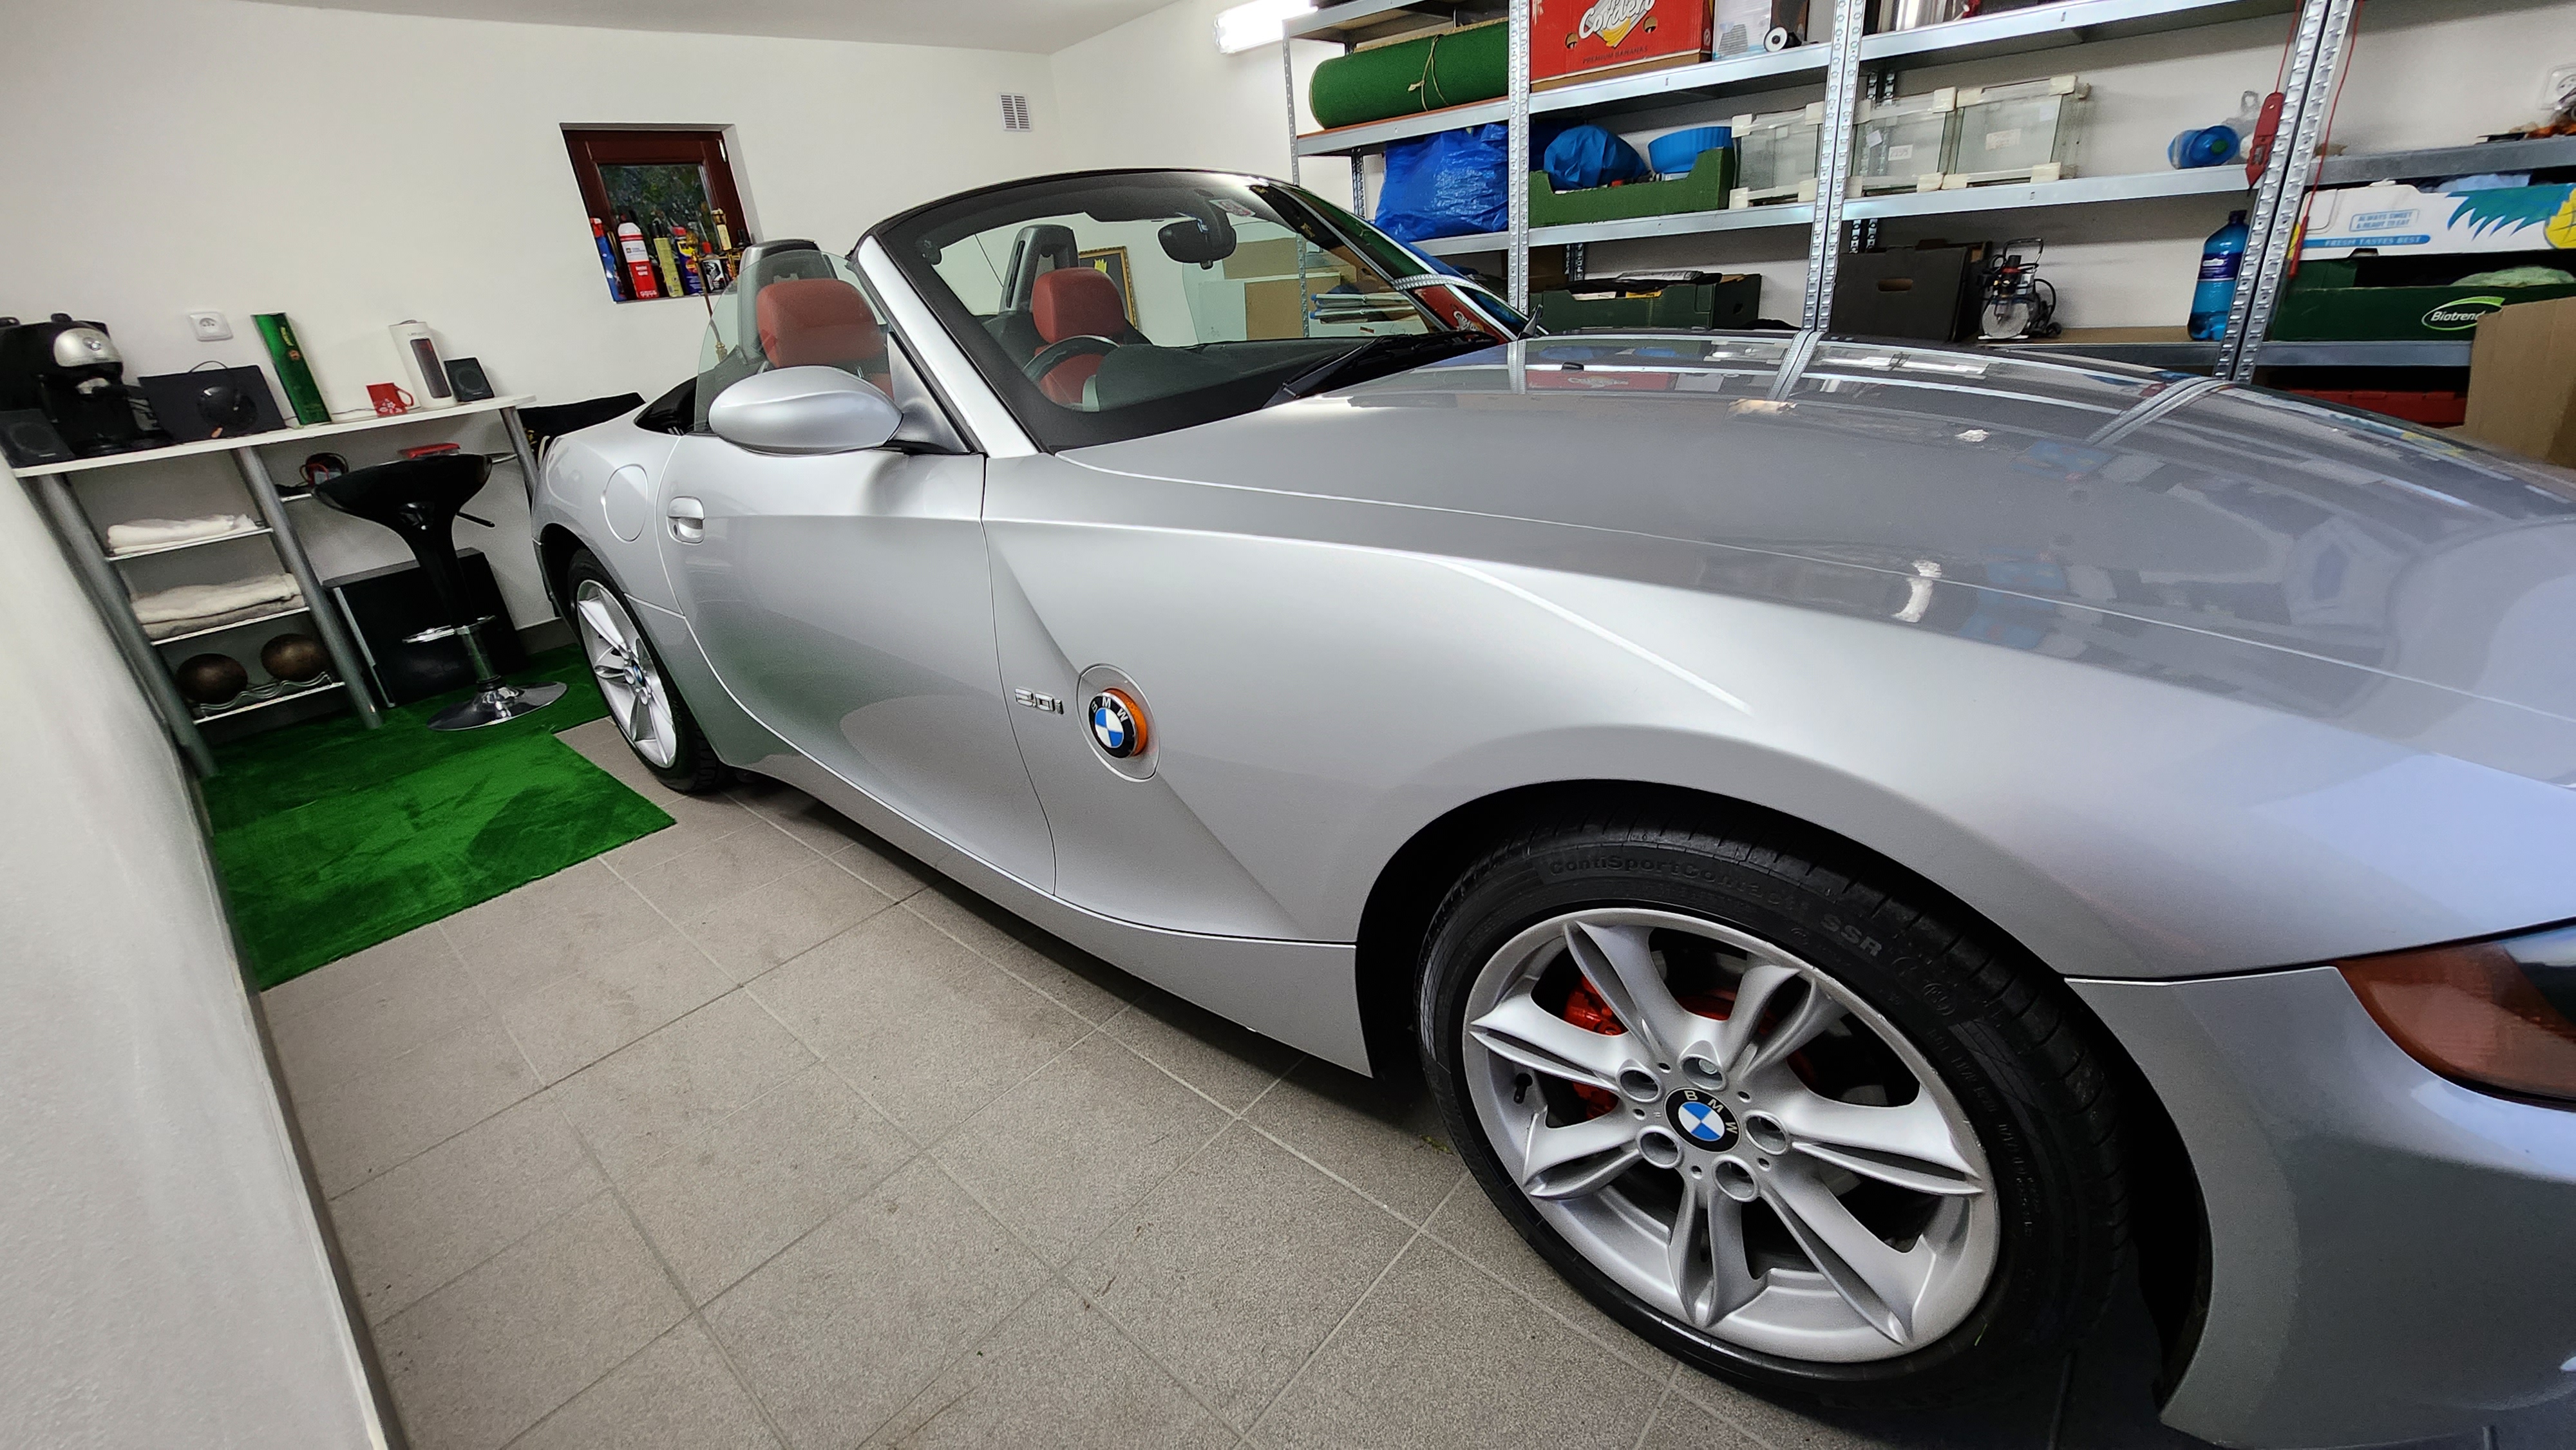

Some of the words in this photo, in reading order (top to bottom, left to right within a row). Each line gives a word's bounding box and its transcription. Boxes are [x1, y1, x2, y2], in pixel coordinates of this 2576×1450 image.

[1582, 52, 1614, 64] PREMIUM
[2358, 214, 2387, 222] ALWAYS
[2325, 239, 2356, 247] FRESH
[2396, 236, 2422, 244] BEST
[1819, 913, 1884, 957] SSR
[1683, 1090, 1738, 1135] BMW
